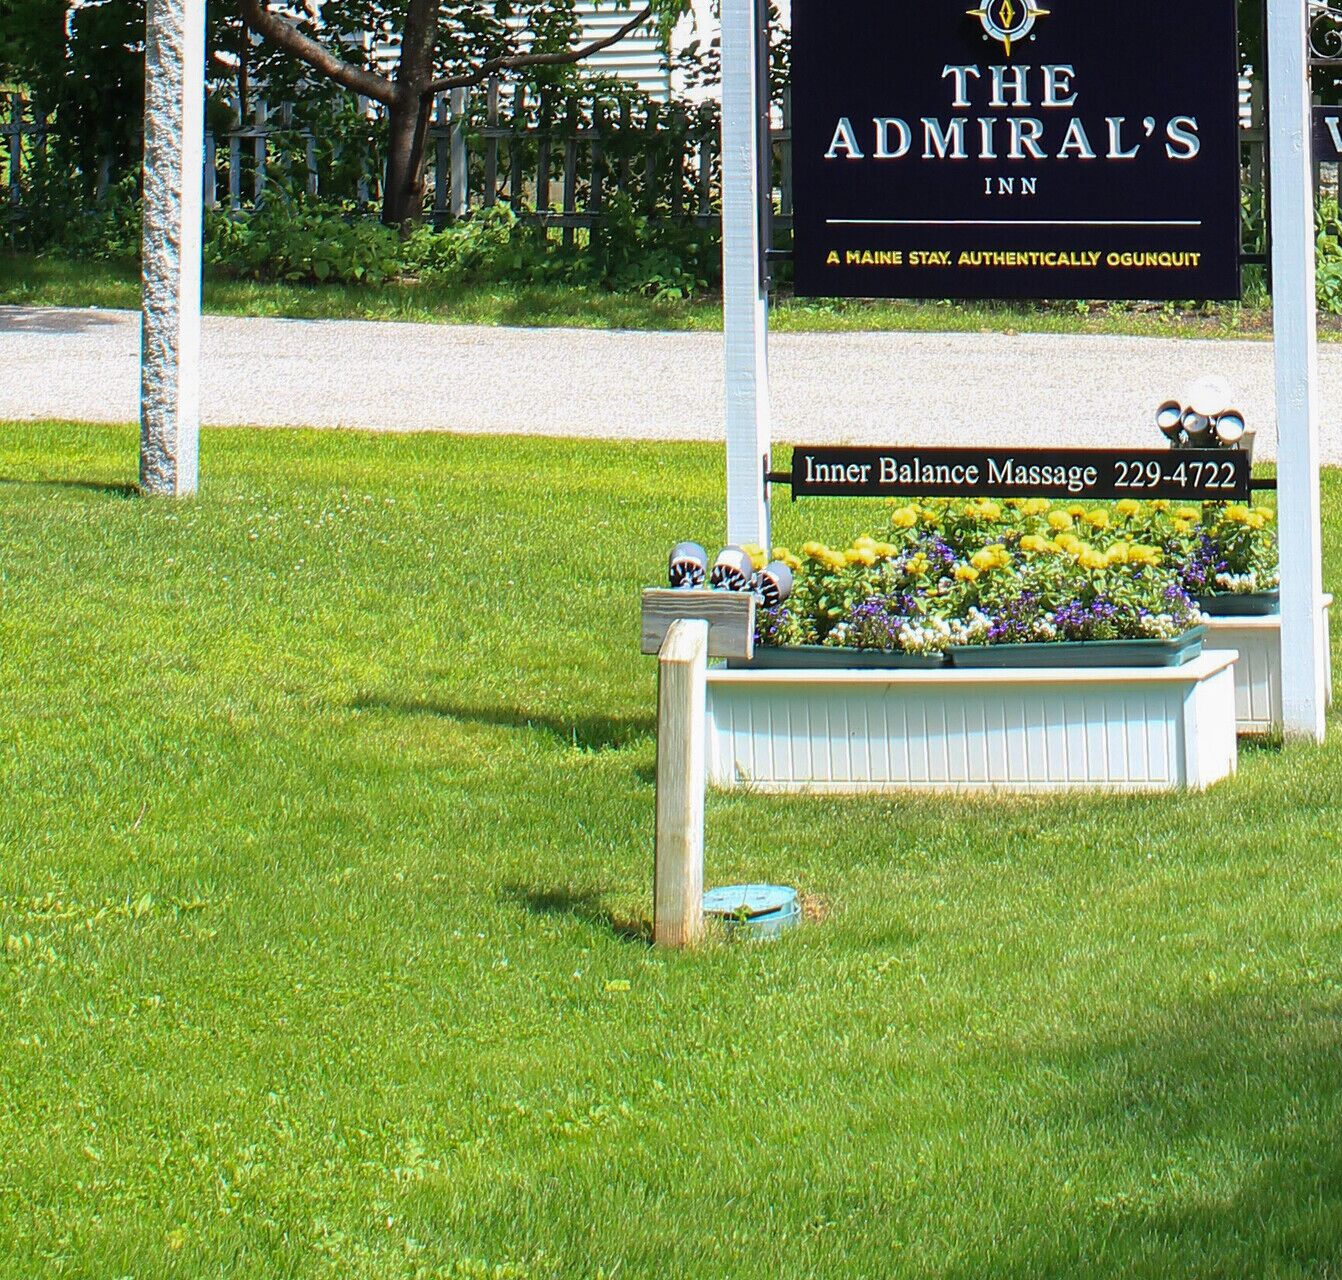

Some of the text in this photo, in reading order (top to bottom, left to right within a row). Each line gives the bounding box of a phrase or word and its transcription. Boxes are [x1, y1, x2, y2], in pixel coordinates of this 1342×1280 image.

[941, 64, 1079, 107] THE
[824, 115, 1200, 159] ADMIRAL'S
[984, 177, 1038, 194] INN
[826, 250, 1201, 268] A MAINE STAY. AUTHENTICALLY OGUNQUIT
[804, 455, 1237, 491] Inner Balance Massage 229-4722
